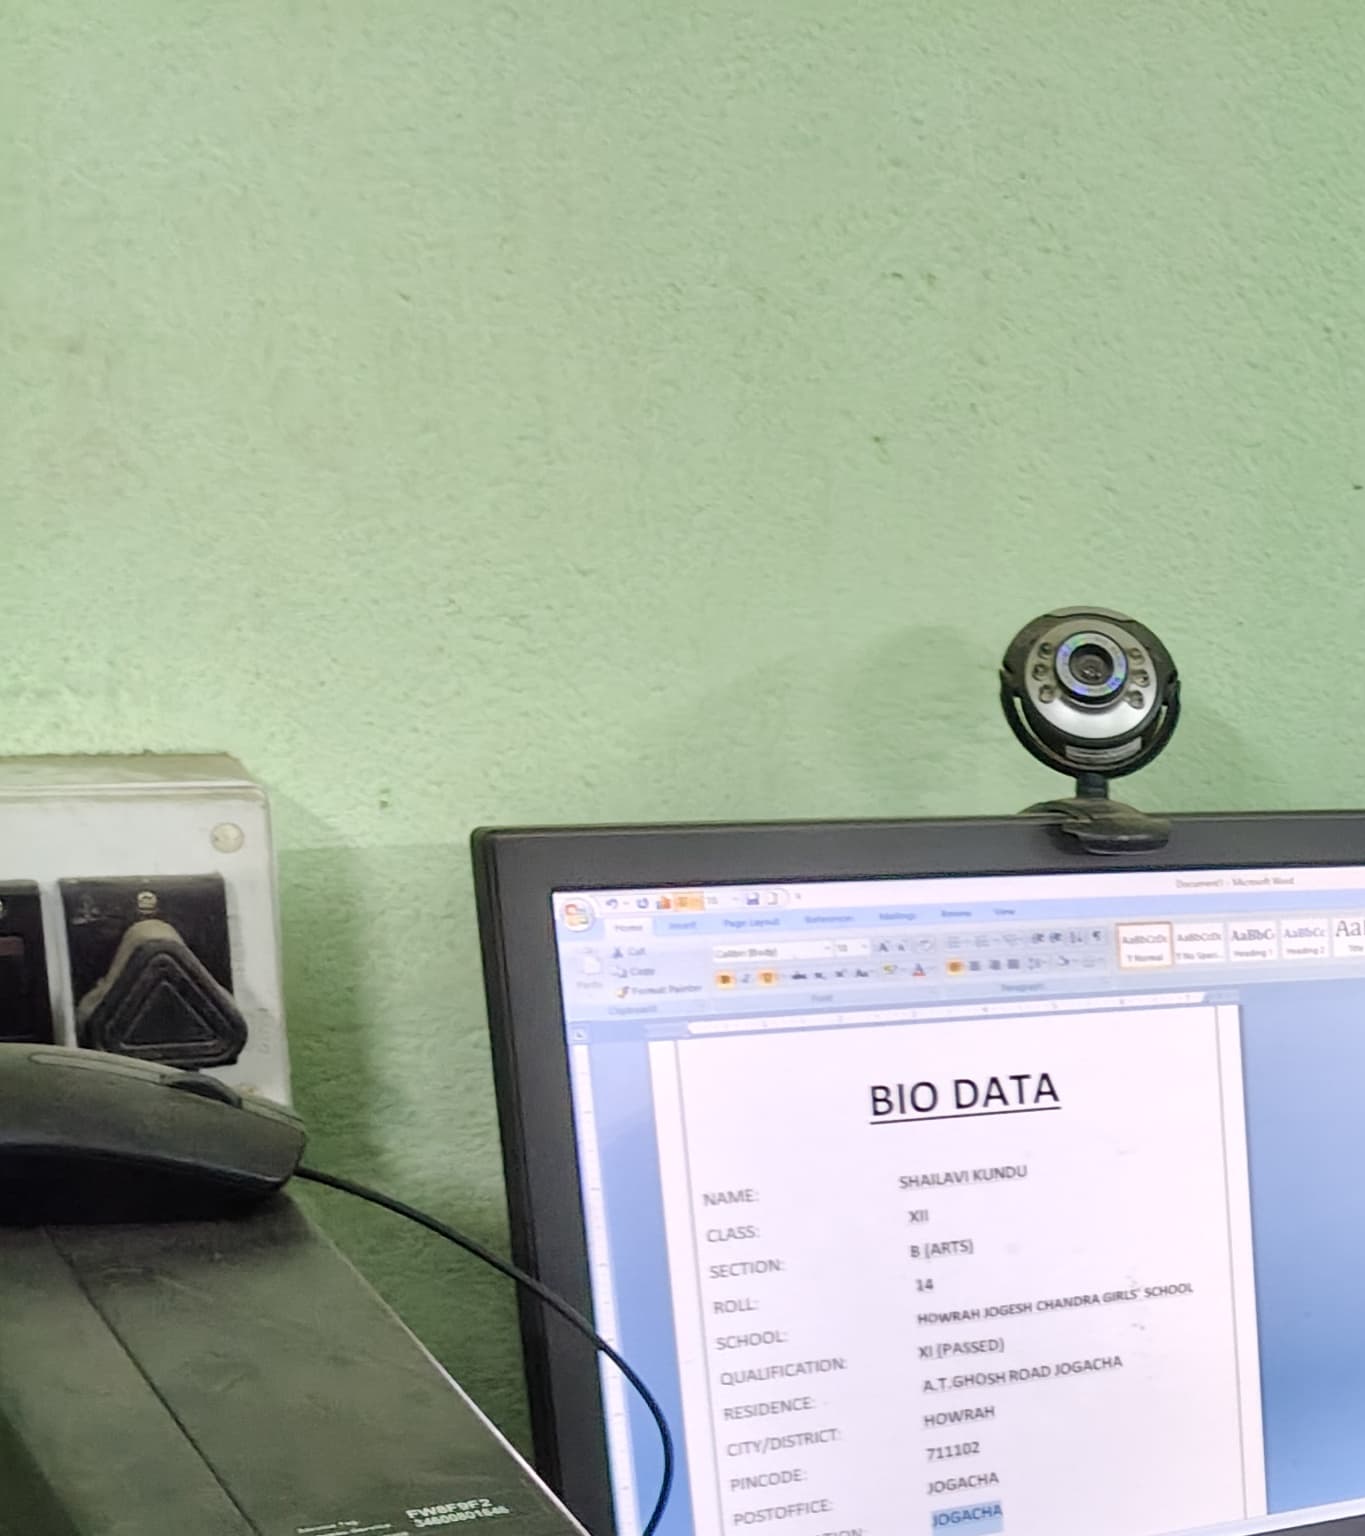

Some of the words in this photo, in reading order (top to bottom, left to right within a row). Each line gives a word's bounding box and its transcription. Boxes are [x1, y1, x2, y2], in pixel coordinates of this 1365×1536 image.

[870, 1081, 939, 1118] BIO
[954, 1072, 1060, 1110] DATA
[703, 1188, 759, 1208] NAME:
[899, 1170, 969, 1190] SHAILAVI
[973, 1164, 1028, 1183] KUNDU
[706, 1225, 761, 1243] CLASS:
[909, 1208, 929, 1224] XII
[709, 1258, 785, 1279] SECTION:
[910, 1244, 920, 1259] B
[924, 1239, 974, 1259] (ARTS)
[713, 1297, 759, 1315] ROLL:
[916, 1278, 934, 1293] 14
[716, 1330, 788, 1350] SCHOOL:
[917, 1308, 981, 1325] HOWRAH
[984, 1302, 1033, 1320] JOGESH
[1036, 1293, 1100, 1313] CHANDRA
[1144, 1282, 1194, 1299] SCHOOL
[720, 1357, 847, 1386] QUALIFICATION:
[919, 1345, 933, 1360] XI
[936, 1338, 1005, 1360] (PASSED)
[723, 1396, 816, 1421] RESIDENCE:
[1009, 1364, 1052, 1384] ROAD
[1055, 1354, 1123, 1379] JOGACHA
[726, 1428, 841, 1458] CITY/DISTRICT:
[924, 1405, 996, 1428] HOWRAH
[730, 1468, 807, 1492] PINCODE:
[926, 1440, 980, 1461] 711102
[733, 1500, 833, 1527] POSTOFFICE:
[927, 1472, 1000, 1496] JOGACHA
[932, 1503, 1003, 1529] JOGACHA
